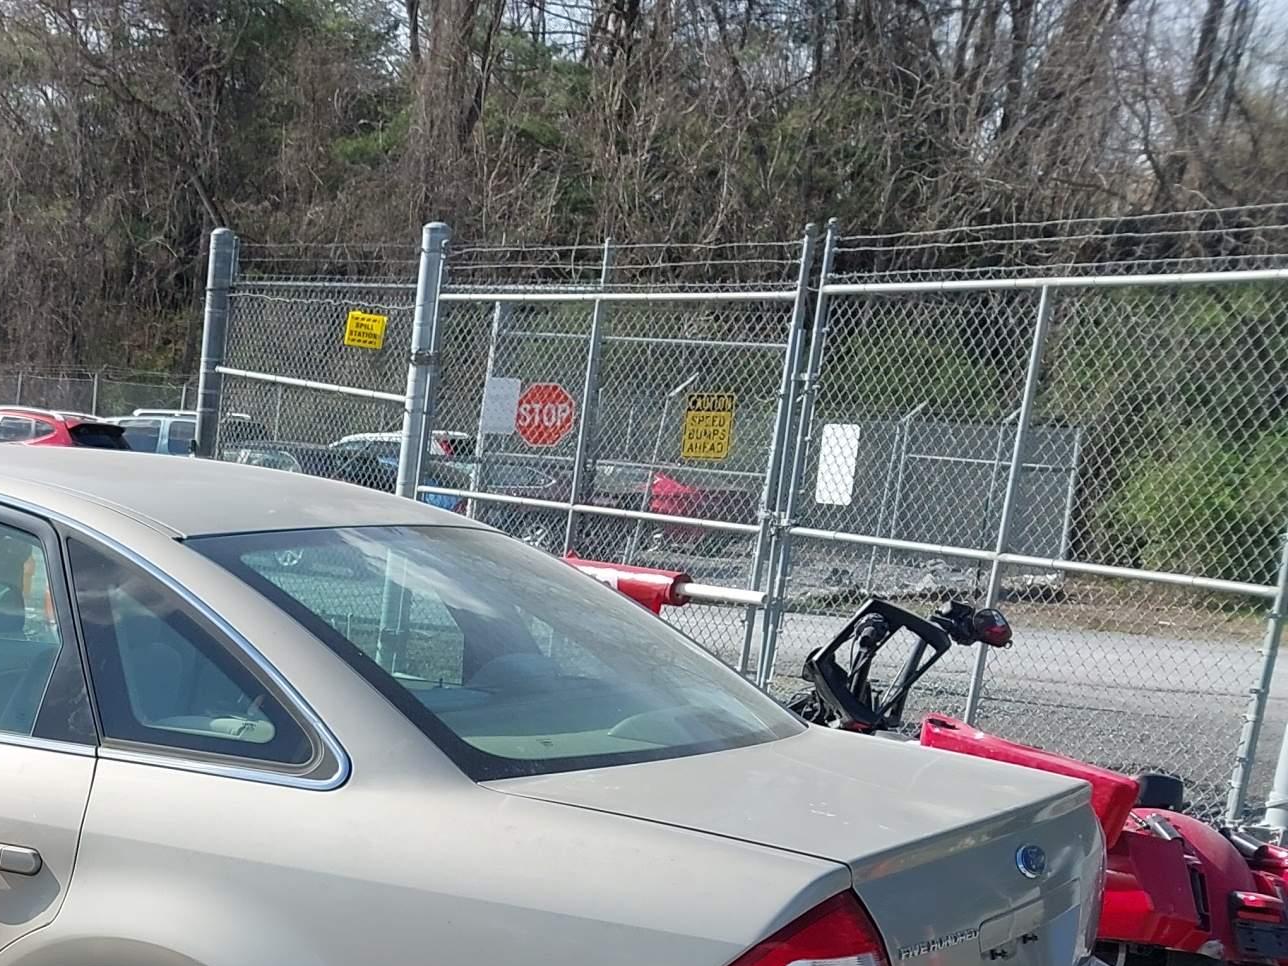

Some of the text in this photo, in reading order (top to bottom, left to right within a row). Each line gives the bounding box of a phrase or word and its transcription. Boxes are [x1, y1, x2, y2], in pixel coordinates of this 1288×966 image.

[355, 322, 374, 330] SPILL
[349, 330, 377, 339] STATION
[518, 403, 569, 427] STOP
[691, 415, 726, 427] SPEED
[687, 429, 726, 440] BUMPS
[687, 442, 724, 453] AHEAD
[899, 929, 979, 960] FIVE HUNDRED
